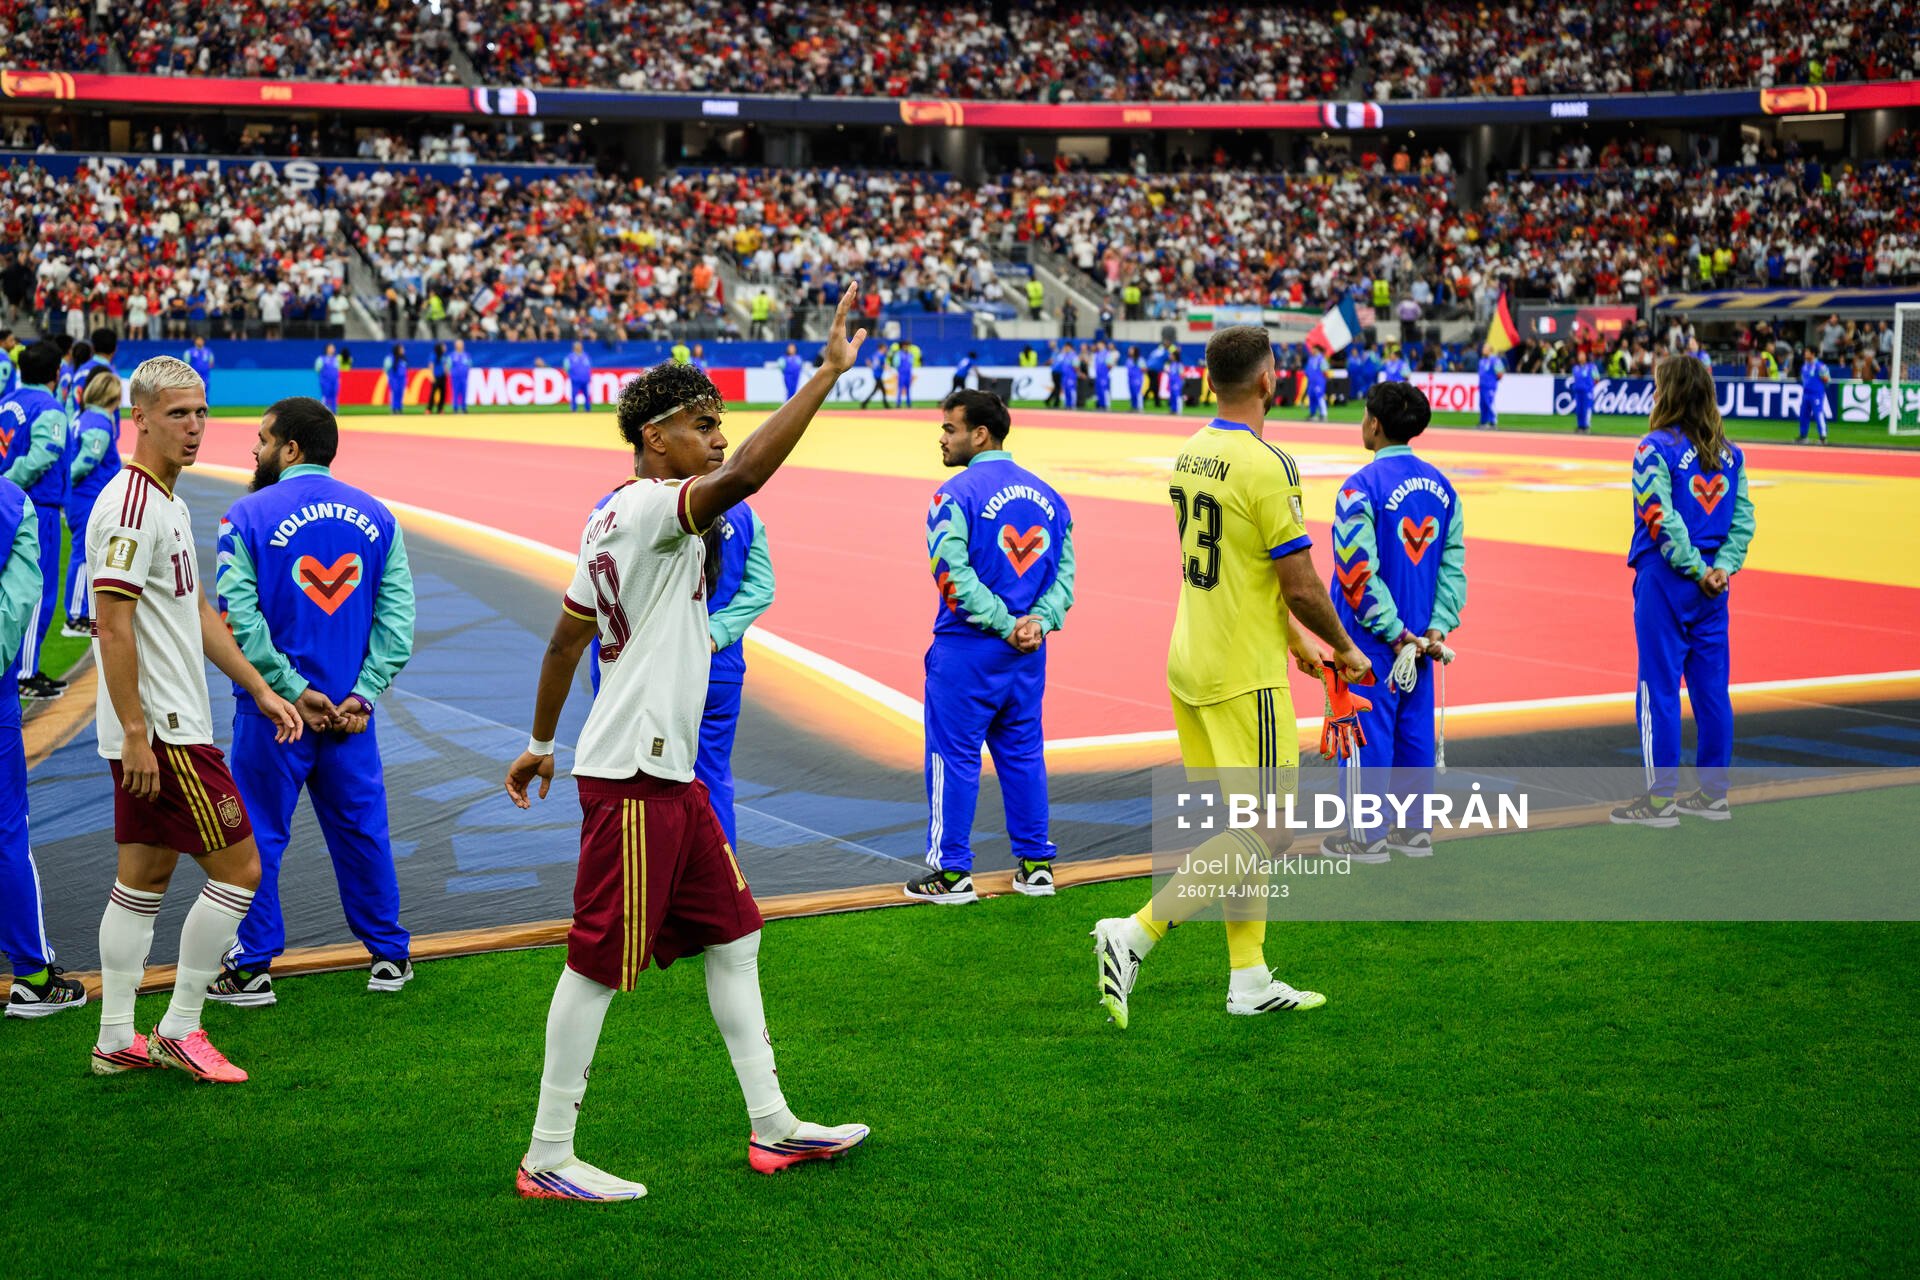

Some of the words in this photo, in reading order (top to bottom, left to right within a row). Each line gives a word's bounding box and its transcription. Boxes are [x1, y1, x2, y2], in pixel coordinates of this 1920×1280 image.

[981, 485, 1055, 520] VOLUNTEER
[1384, 477, 1450, 511] VOLUNTEER
[269, 502, 380, 548] VOLUNTEER
[171, 549, 194, 598] 10
